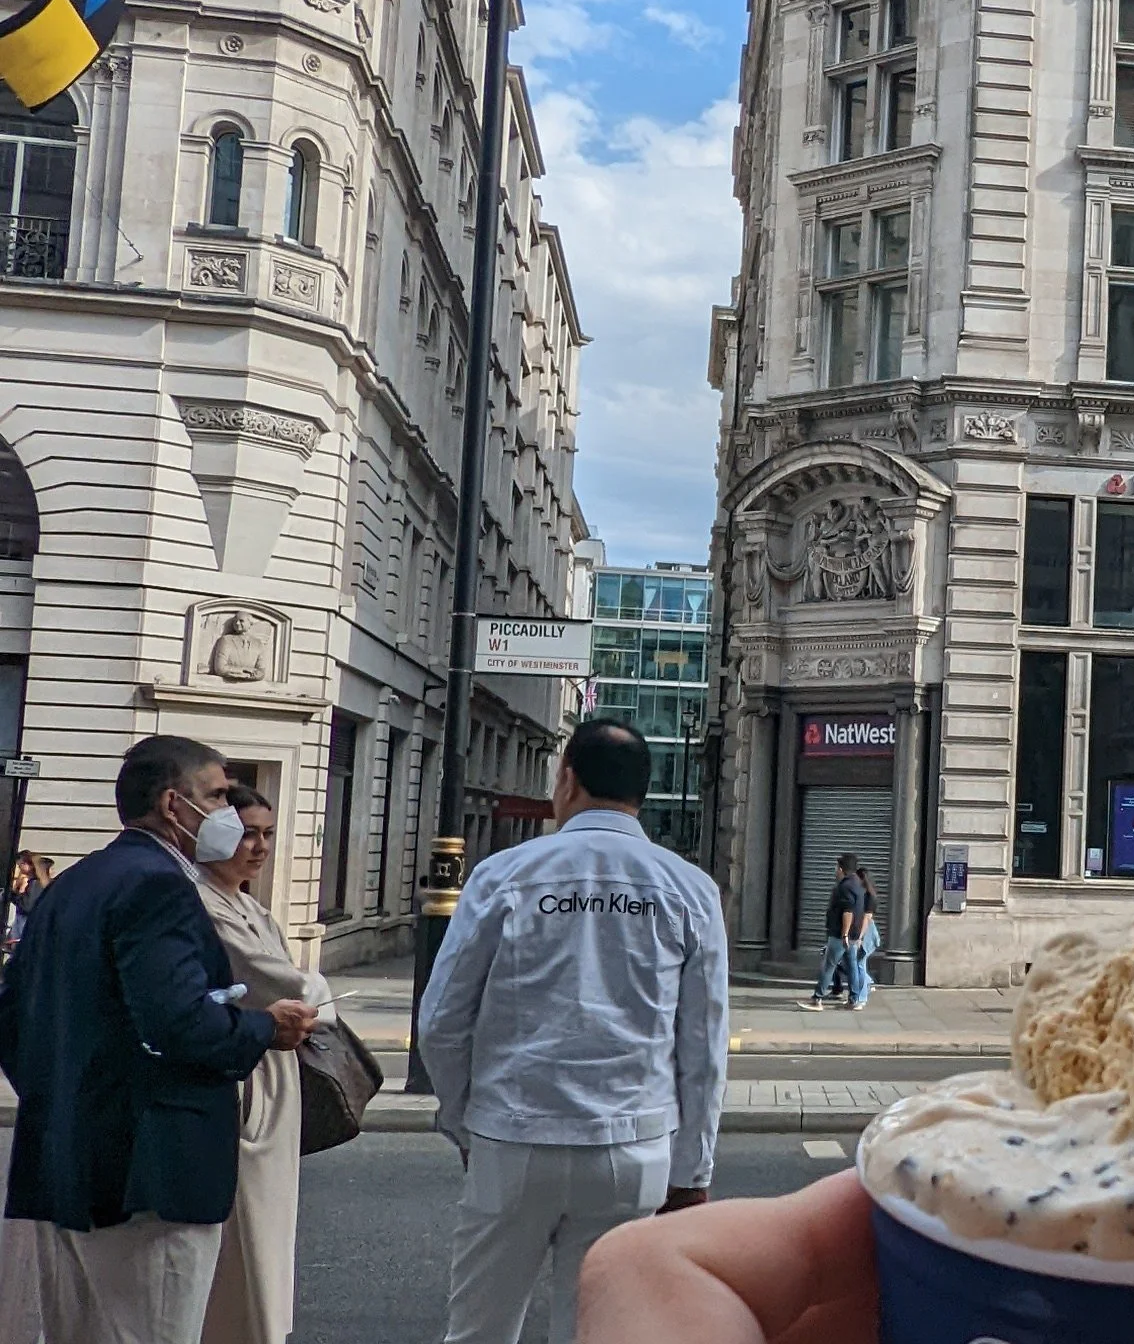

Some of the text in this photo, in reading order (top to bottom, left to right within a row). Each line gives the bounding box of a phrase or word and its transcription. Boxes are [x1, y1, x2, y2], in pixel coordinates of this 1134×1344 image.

[490, 623, 565, 638] PICCADILLY
[489, 639, 508, 651] W1
[488, 659, 579, 671] CITY OF WESTMINSTER
[825, 723, 896, 744] NatWest
[539, 892, 656, 916] Calvin Klein
